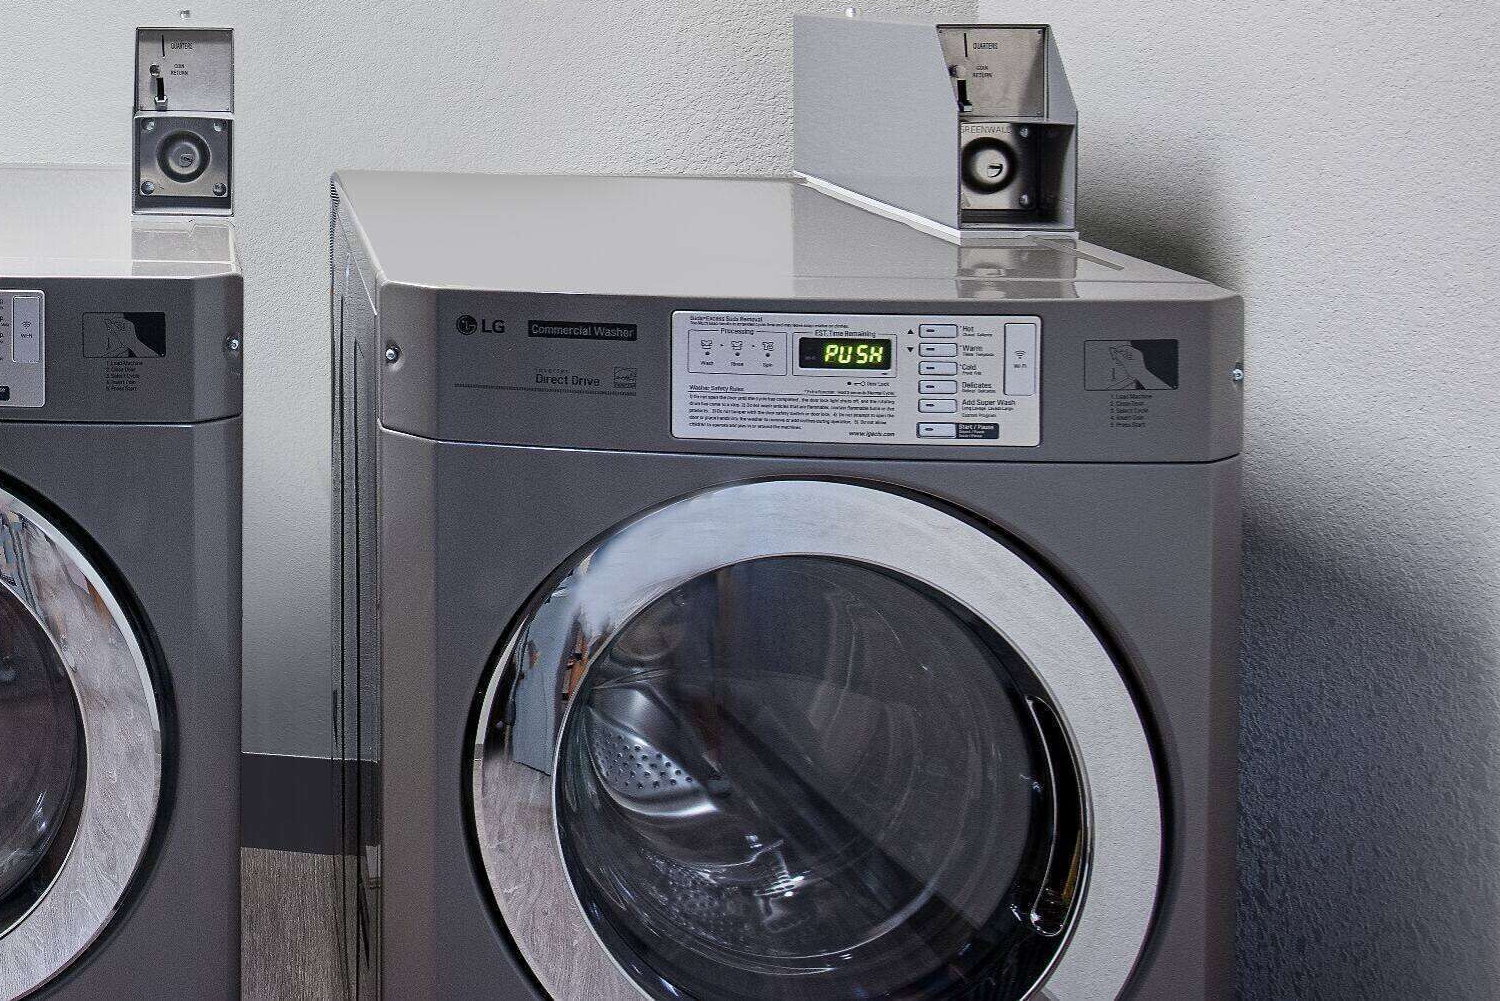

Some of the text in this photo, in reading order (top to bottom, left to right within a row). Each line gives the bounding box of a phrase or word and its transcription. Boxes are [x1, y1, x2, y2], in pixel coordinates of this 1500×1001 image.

[481, 319, 505, 334] LG
[531, 324, 635, 338] Commercial Washer
[824, 344, 884, 364] PUSH
[535, 374, 569, 385] Direct
[571, 375, 601, 387] Drive
[711, 385, 729, 393] Safety
[976, 400, 996, 408] Super
